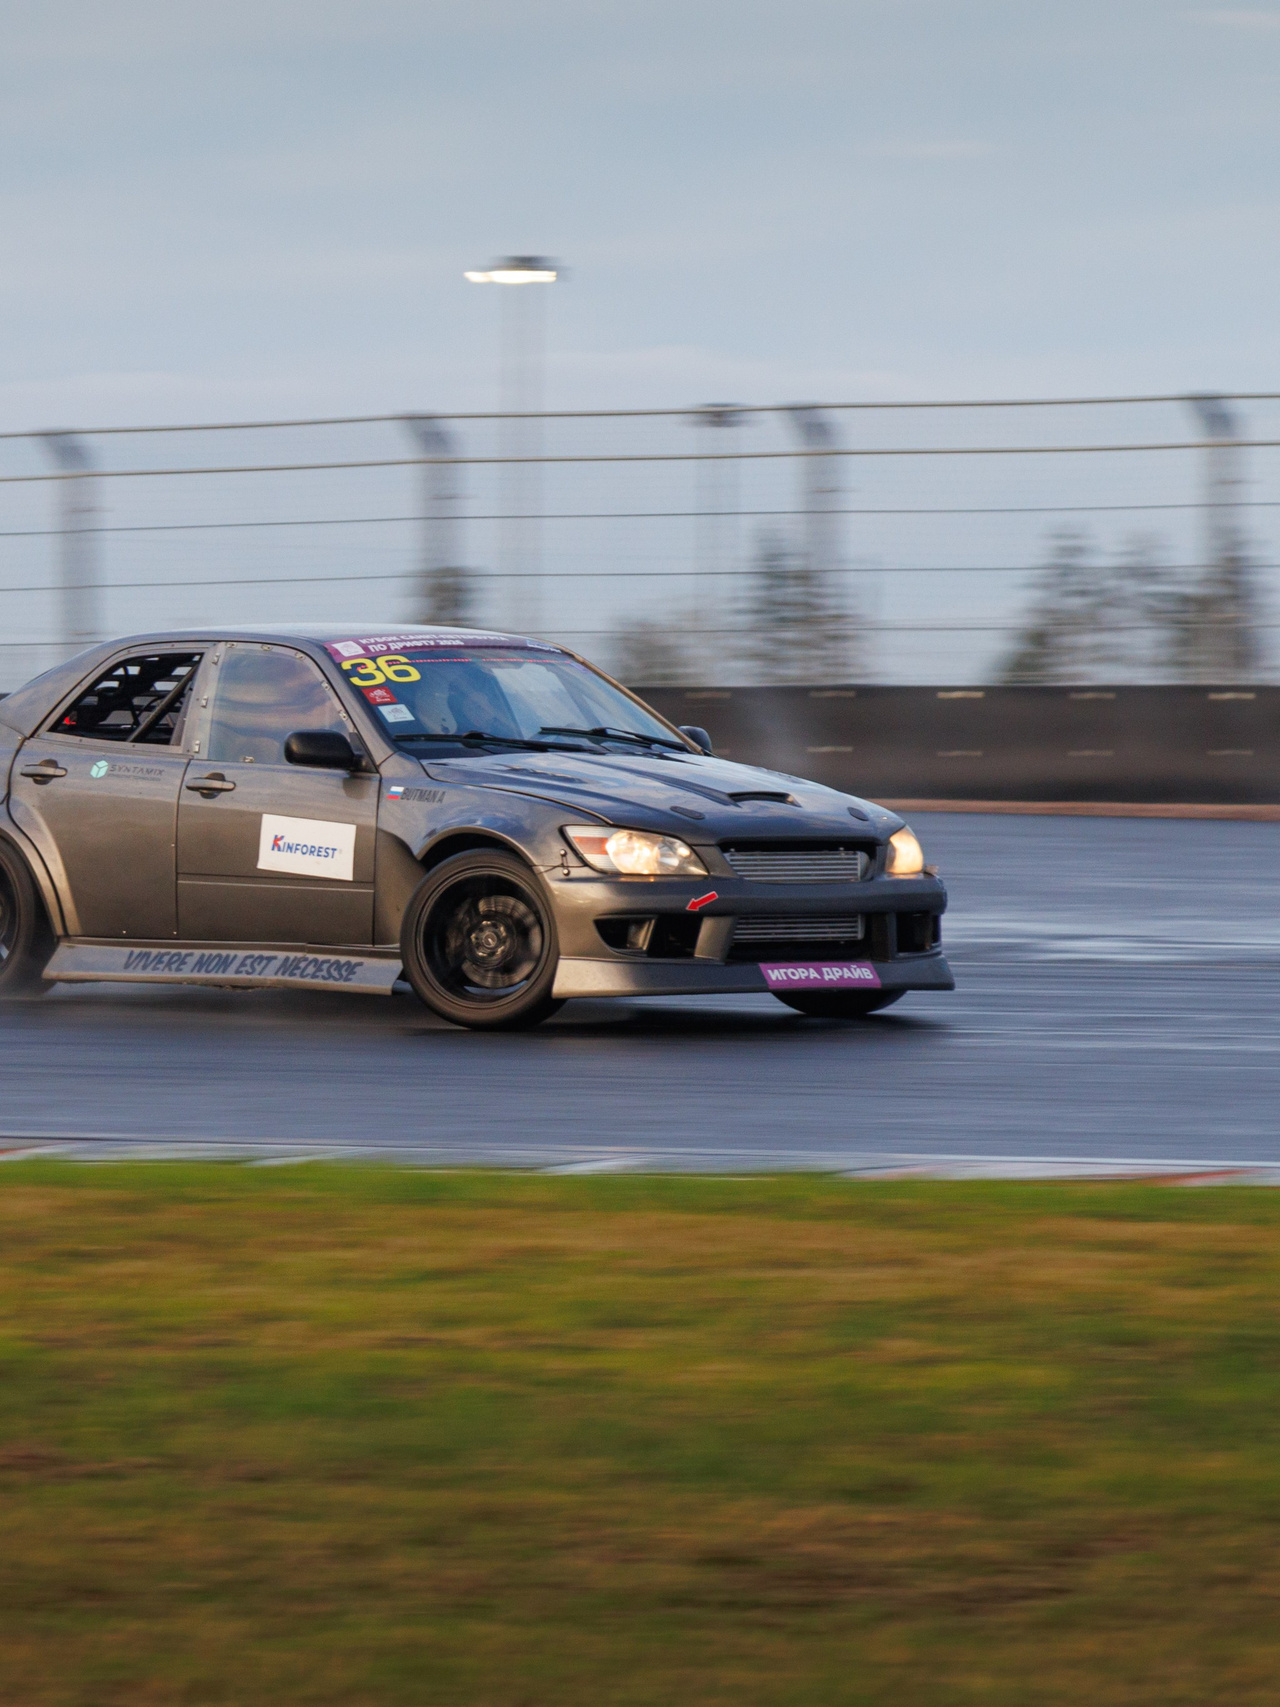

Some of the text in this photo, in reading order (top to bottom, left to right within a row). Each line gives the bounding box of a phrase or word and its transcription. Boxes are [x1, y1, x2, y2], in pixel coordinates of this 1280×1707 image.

[368, 644, 388, 653] ПО
[388, 640, 435, 651] ДРИФТУ
[341, 655, 421, 686] 36
[109, 764, 165, 776] SYNTAMIX
[271, 834, 338, 859] KINFOREST
[123, 950, 194, 972] VIVERE
[190, 952, 237, 974] NON
[234, 954, 277, 976] EST
[767, 964, 874, 981] ИГОРА ДРАЙВ
